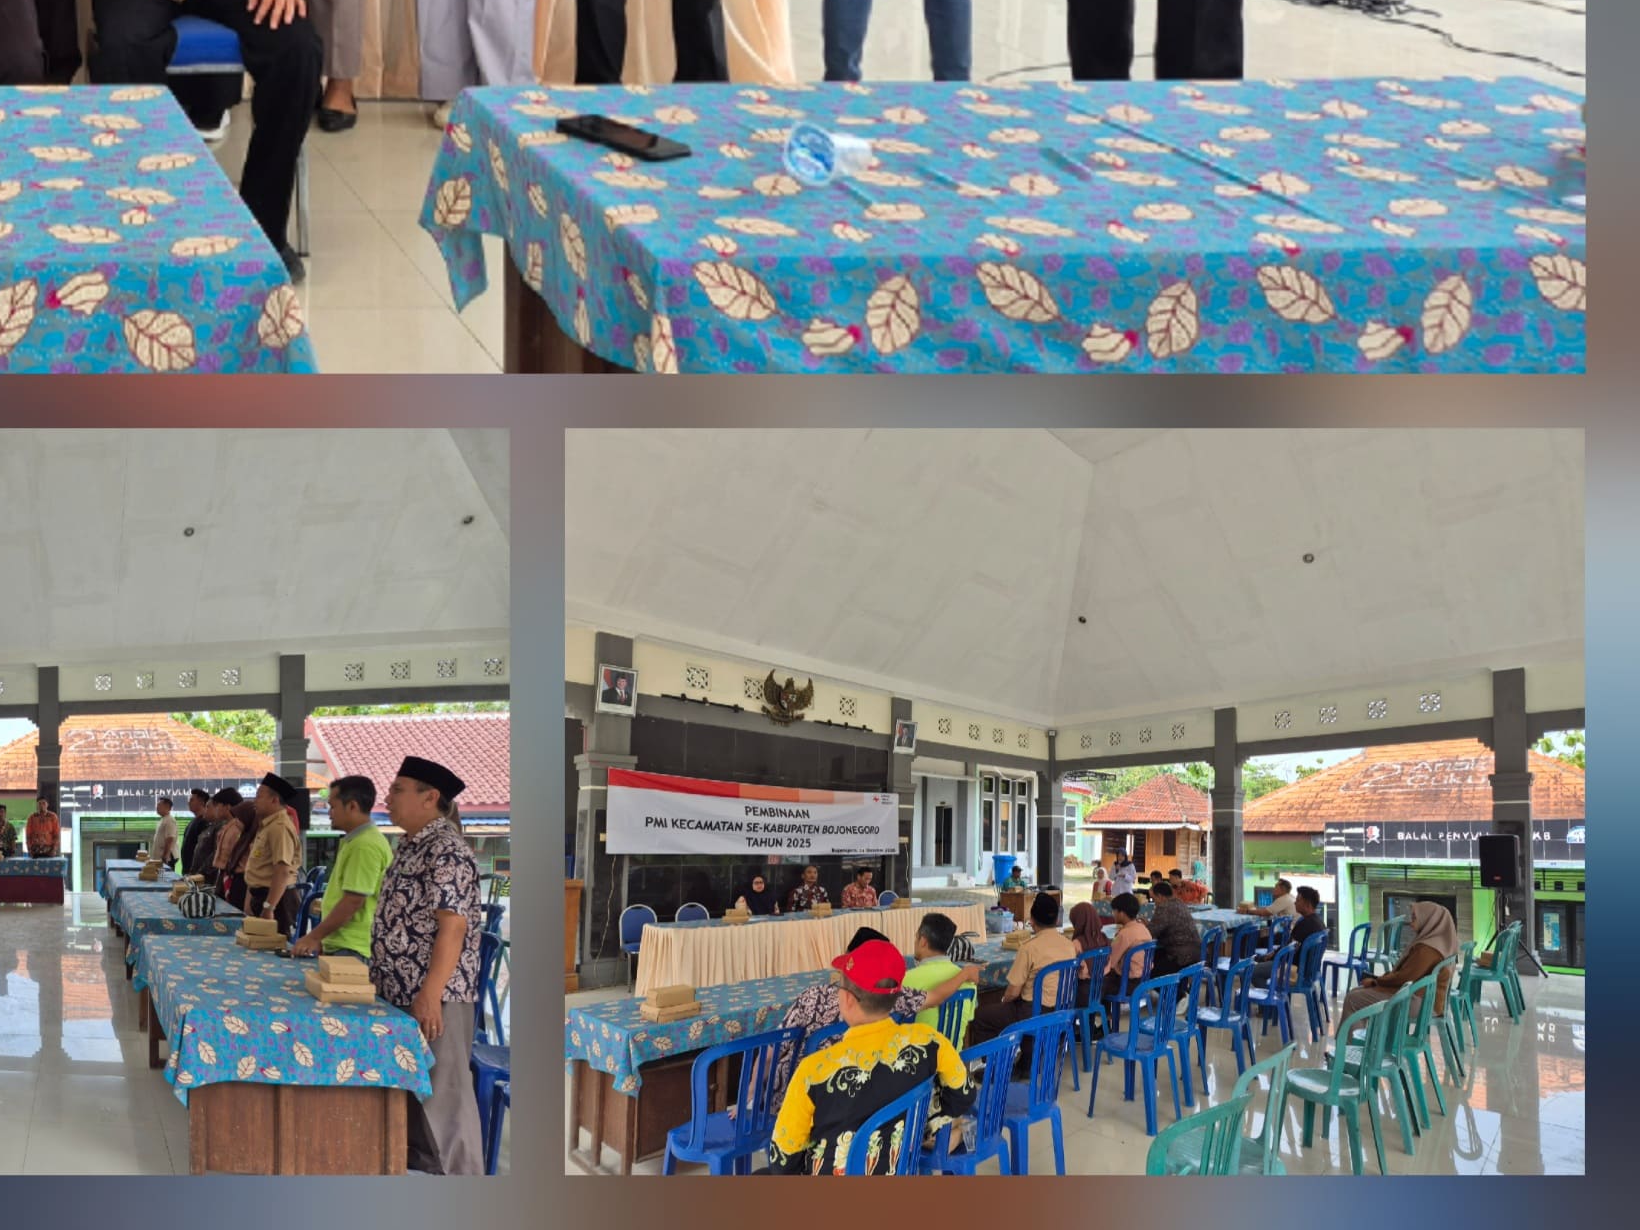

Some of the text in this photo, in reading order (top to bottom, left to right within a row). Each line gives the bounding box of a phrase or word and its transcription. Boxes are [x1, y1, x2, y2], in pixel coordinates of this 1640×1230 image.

[744, 806, 811, 819] PEMBINAAN
[645, 817, 880, 835] PMI KECAMATAN SE-KABUPATEN BOJONEGORO
[746, 837, 812, 848] TAHUN 2025
